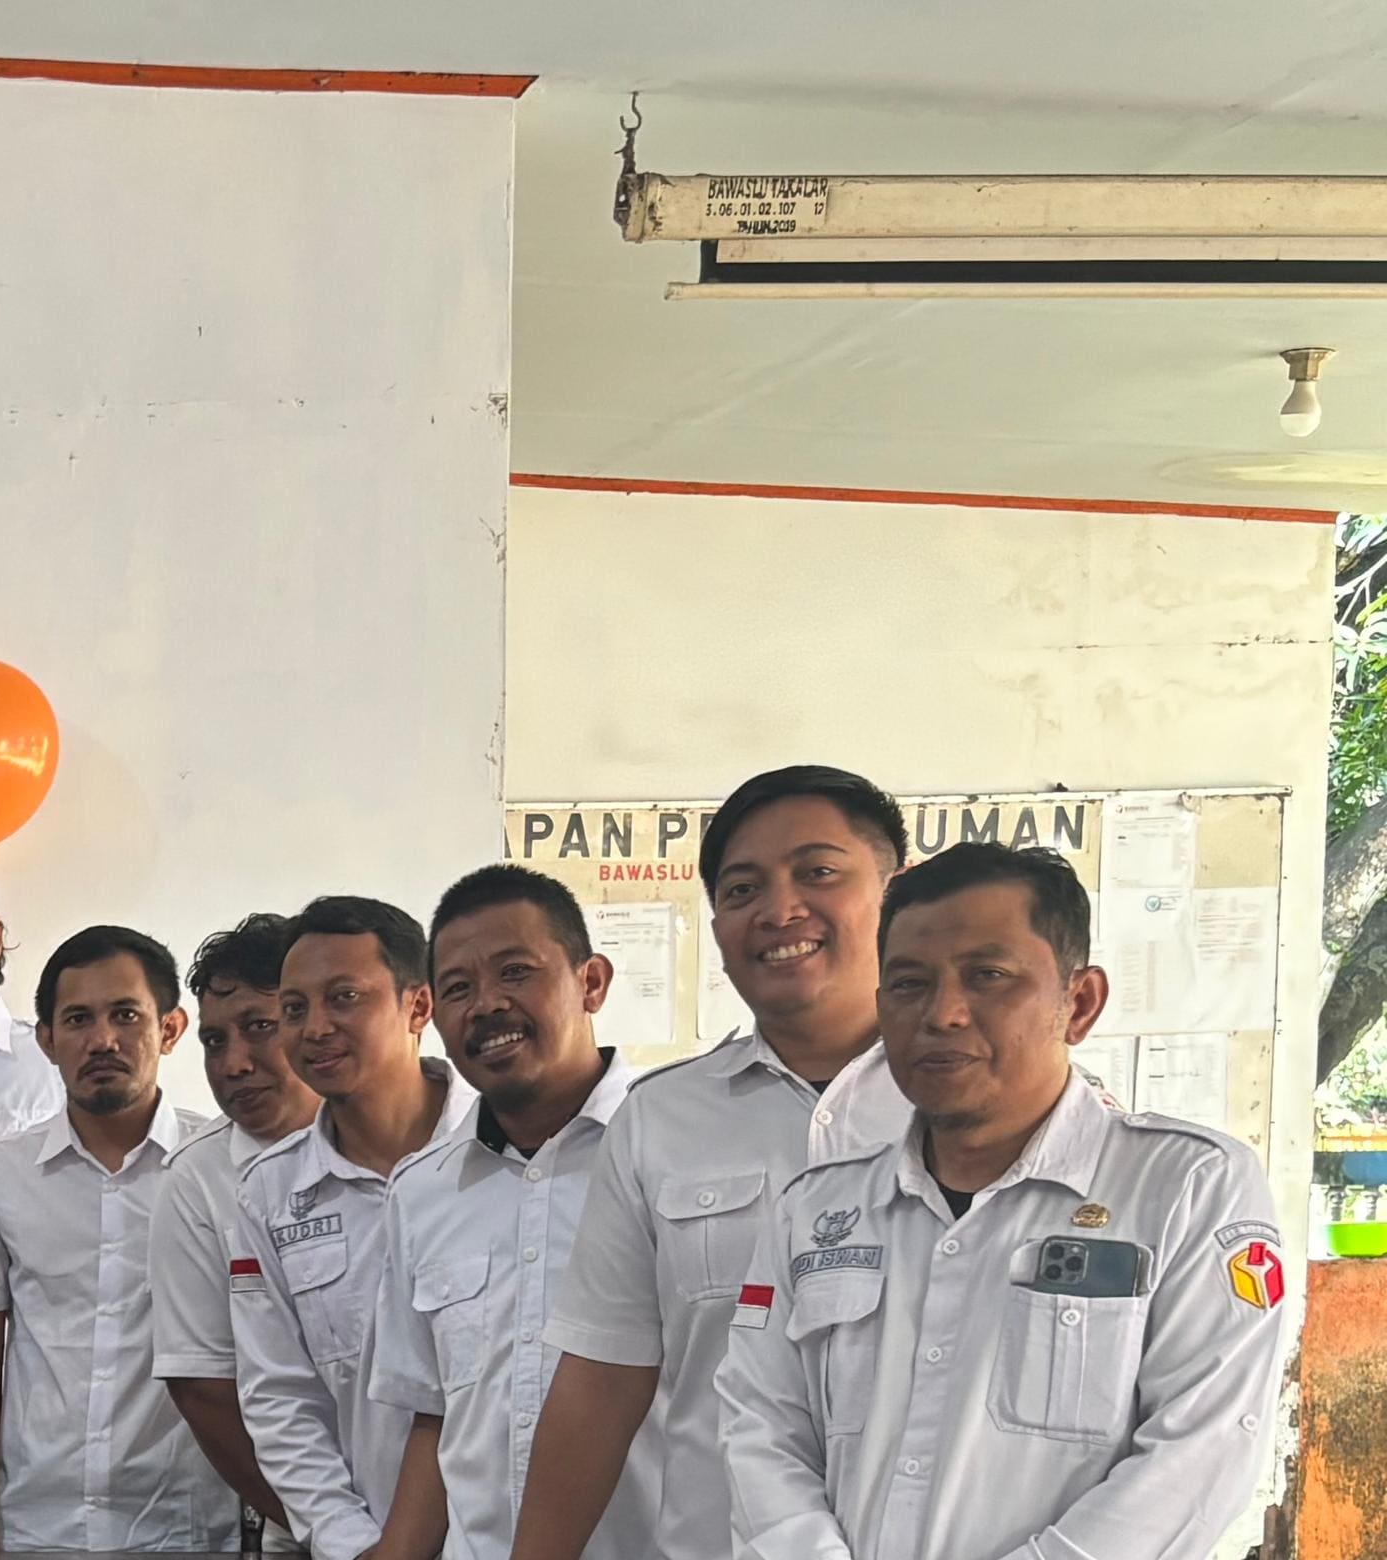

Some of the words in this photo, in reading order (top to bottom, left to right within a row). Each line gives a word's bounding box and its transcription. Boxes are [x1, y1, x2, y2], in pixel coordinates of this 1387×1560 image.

[708, 178, 768, 199] BAWASLU
[771, 178, 827, 198] TAKALAR
[599, 864, 694, 881] BAWASLU
